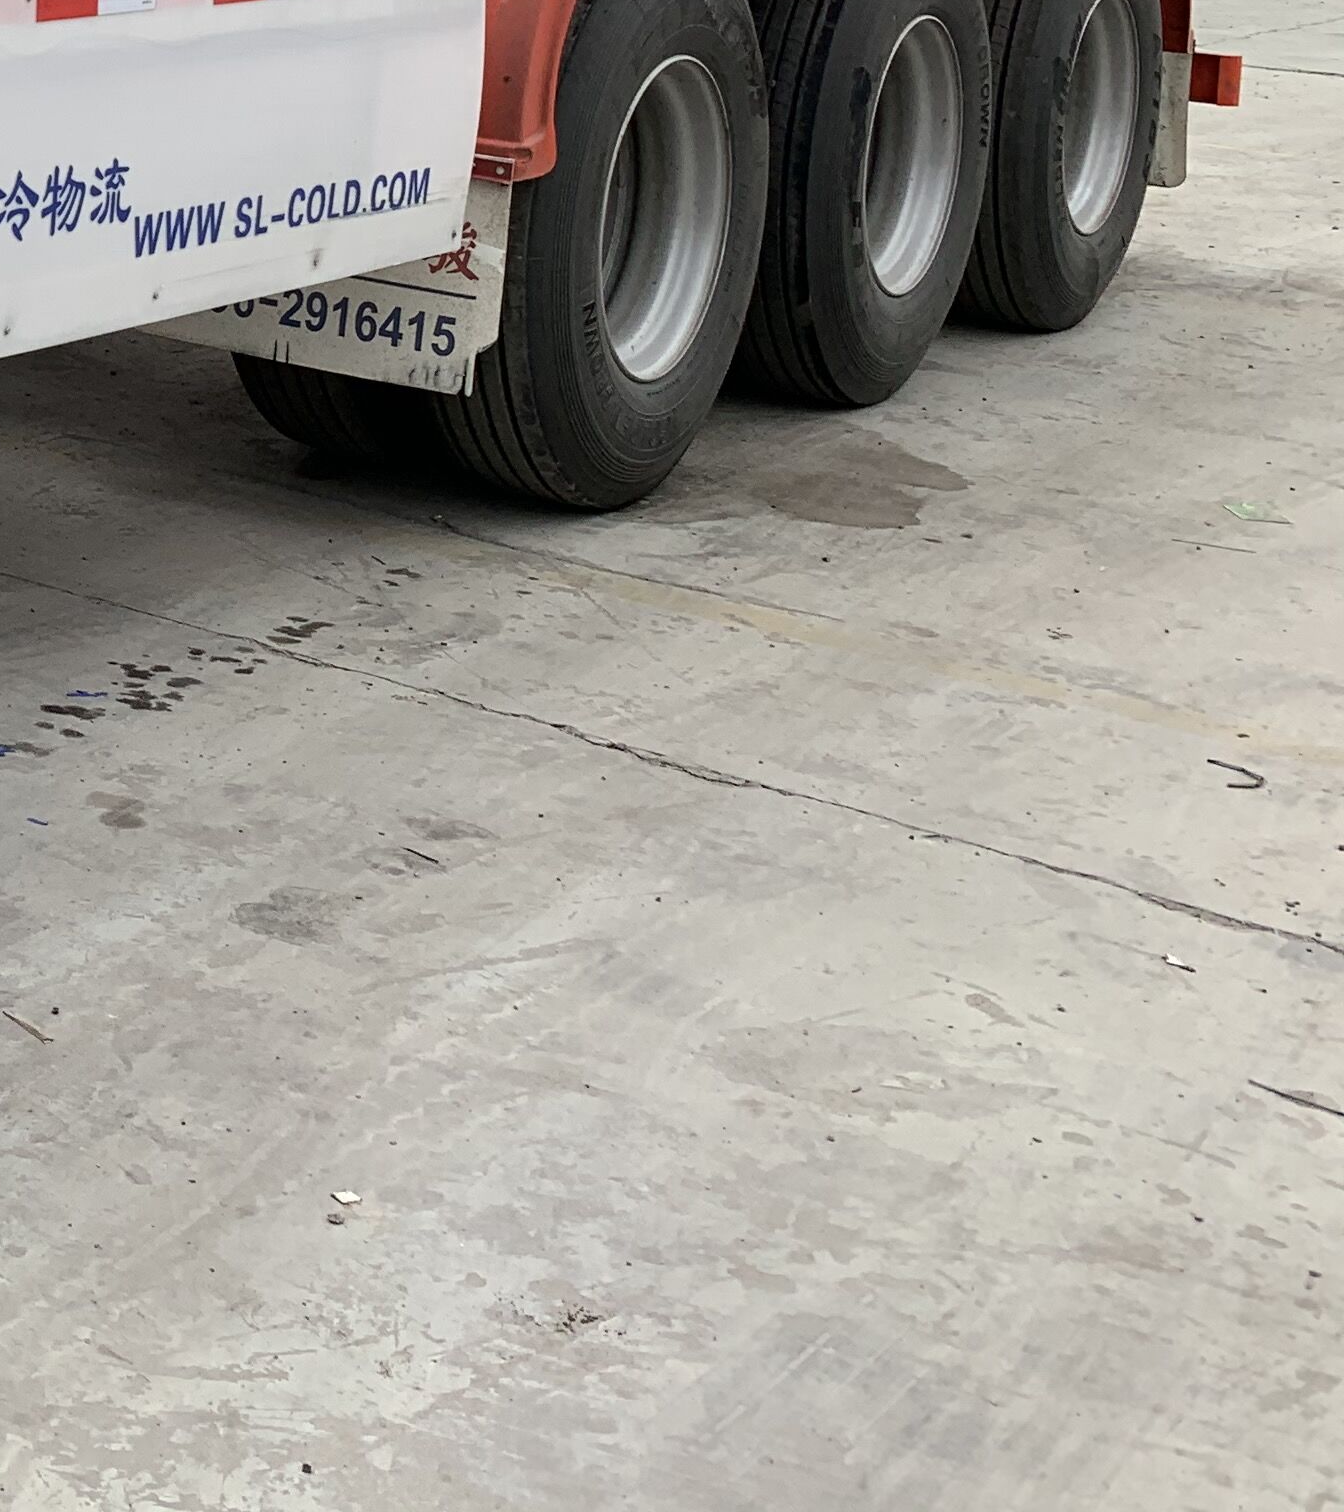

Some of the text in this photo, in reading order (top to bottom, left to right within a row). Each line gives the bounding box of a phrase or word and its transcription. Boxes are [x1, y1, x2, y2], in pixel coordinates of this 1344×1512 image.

[134, 201, 226, 258] WWW
[234, 167, 431, 238] SL-COLD.COM
[210, 288, 458, 357] -2916415
